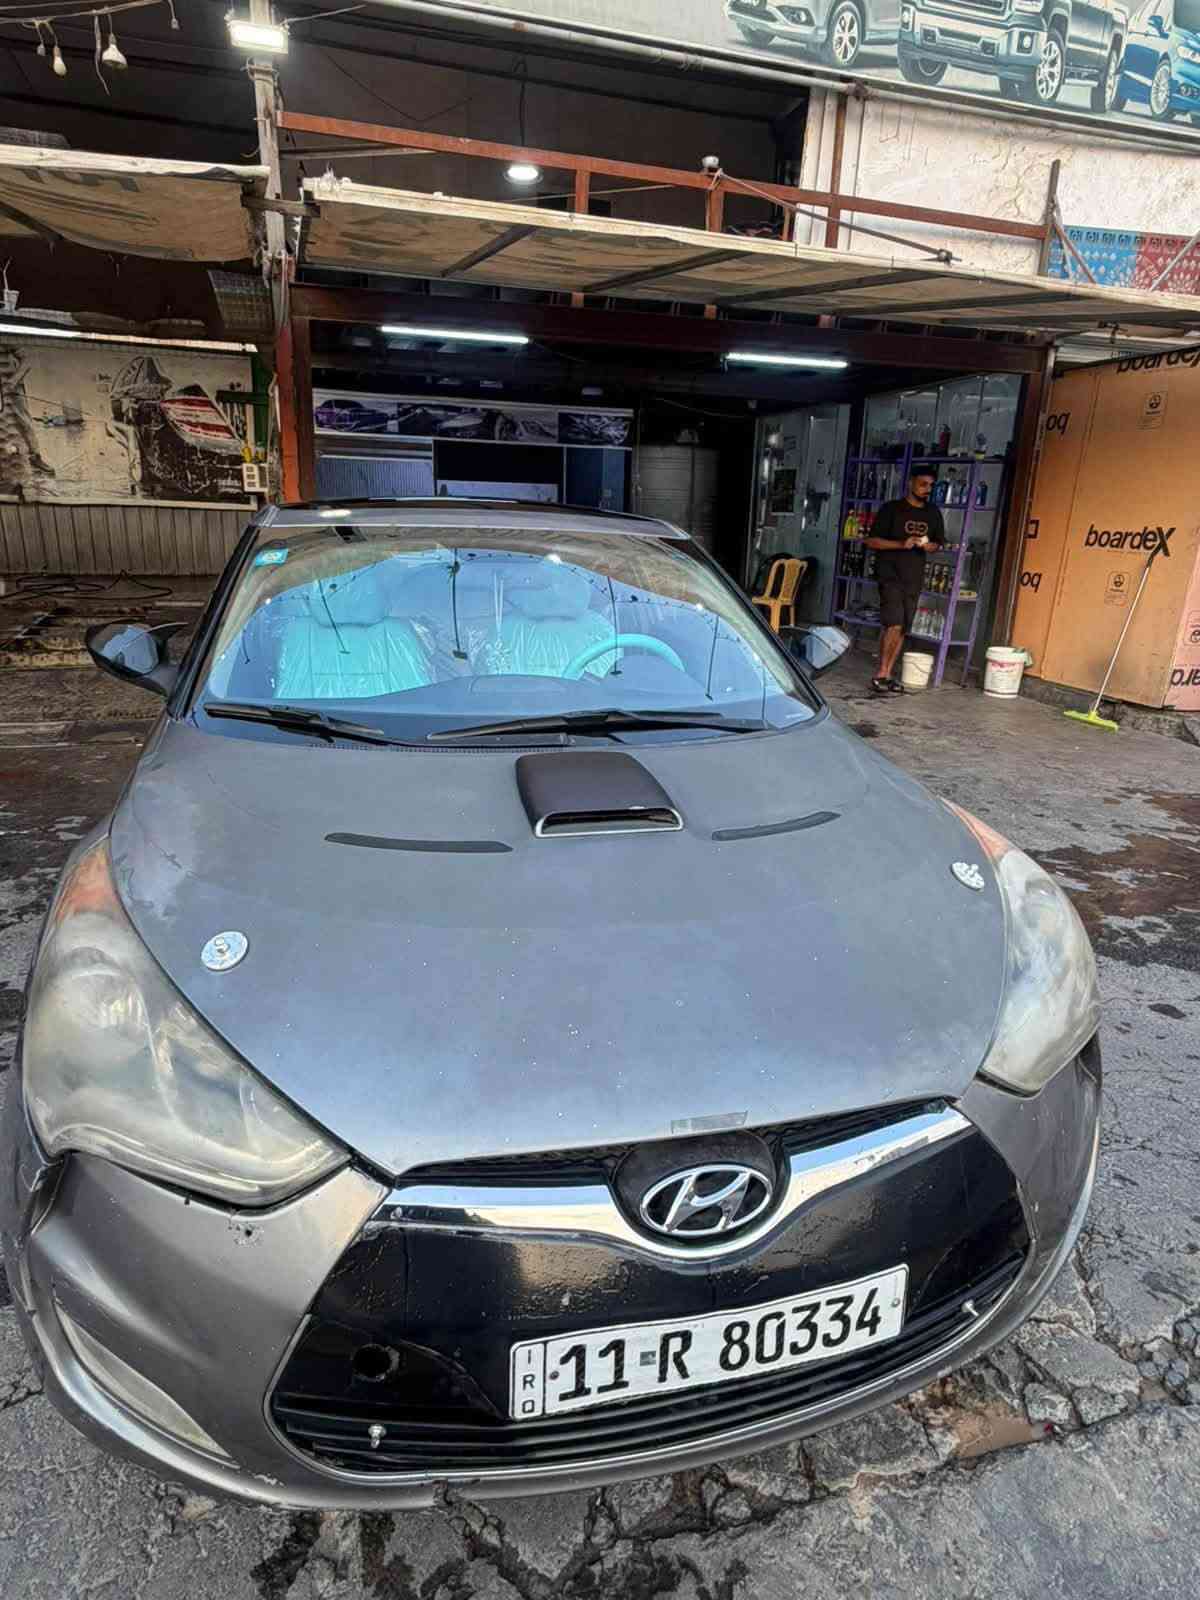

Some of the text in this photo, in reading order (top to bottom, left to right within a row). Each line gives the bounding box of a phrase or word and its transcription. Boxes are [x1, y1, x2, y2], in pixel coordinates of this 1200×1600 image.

[557, 1287, 882, 1402] 11 R 80334
